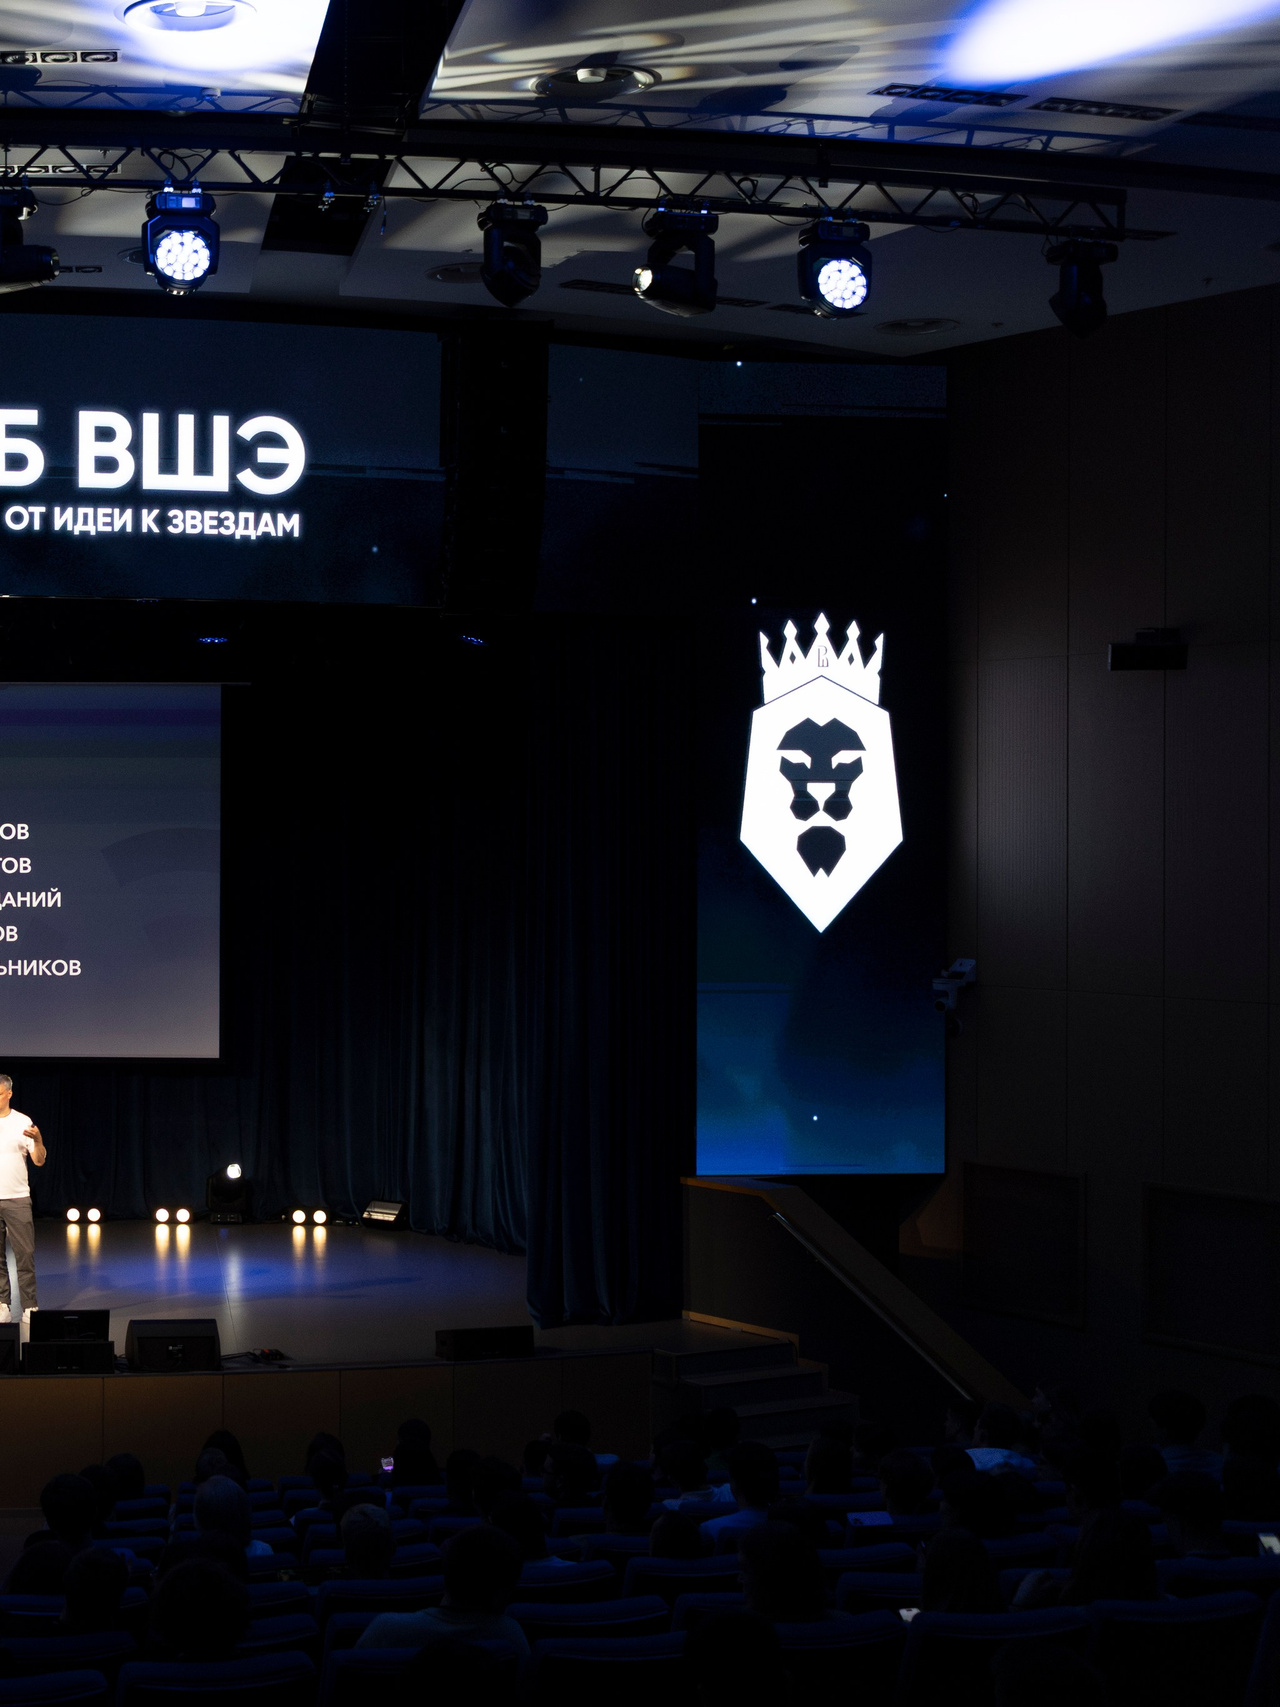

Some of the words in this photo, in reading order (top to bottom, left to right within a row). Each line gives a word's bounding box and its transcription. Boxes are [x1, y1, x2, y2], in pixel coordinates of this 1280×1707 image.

[77, 410, 307, 497] ВШЭ
[4, 505, 47, 531] ОТ
[53, 506, 133, 536] ИДЕИ
[141, 508, 161, 533] К
[166, 508, 301, 539] ЗВЕЗДАМ
